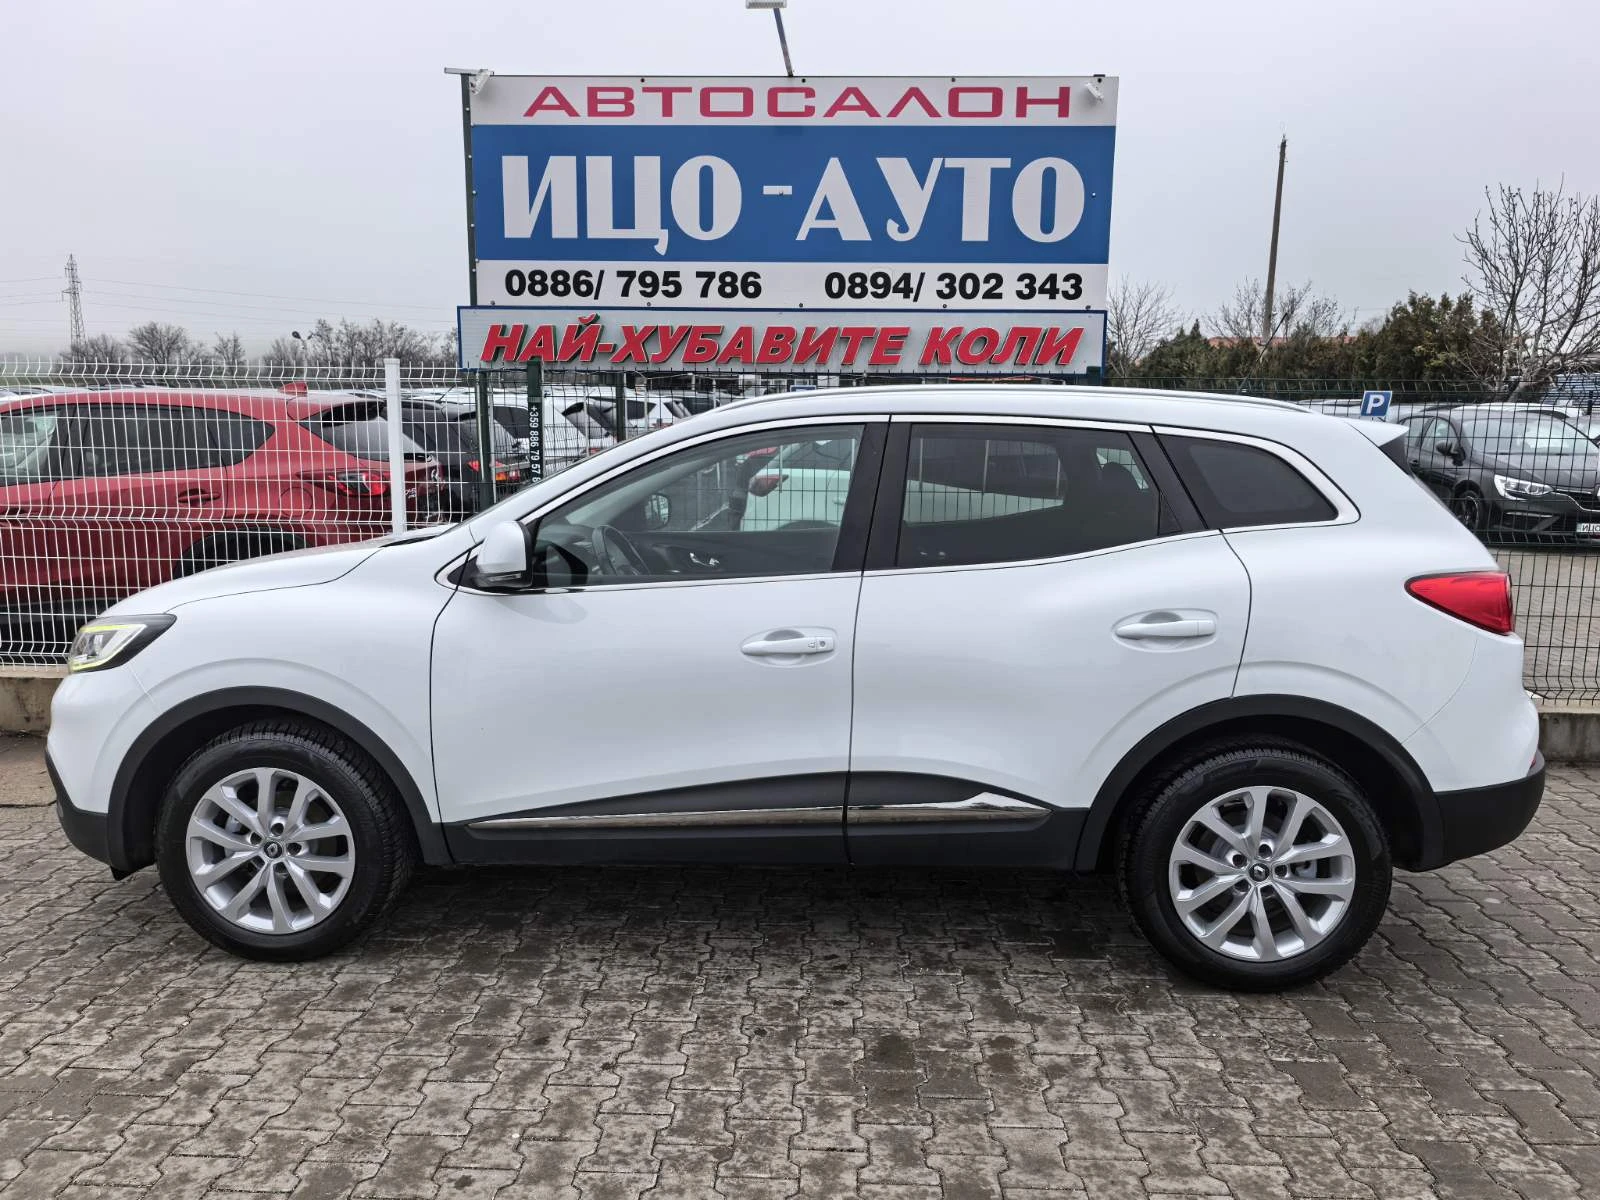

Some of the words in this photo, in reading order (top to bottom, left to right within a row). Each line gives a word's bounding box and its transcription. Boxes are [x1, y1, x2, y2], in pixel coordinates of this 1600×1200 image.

[523, 85, 1071, 118] АВТОСАЛОН
[504, 269, 604, 300] 0886/
[616, 270, 682, 299] 795
[695, 270, 762, 299] 786
[824, 271, 925, 302] 0894/
[936, 273, 1003, 301] 302
[1016, 273, 1083, 301] 343
[481, 313, 911, 367] НАЙ-ХУБАВИТЕ
[918, 324, 1084, 367] КОЛИ
[1366, 394, 1385, 414] P
[529, 405, 539, 428] +359
[530, 430, 539, 447] 886
[530, 449, 540, 461] 79
[531, 463, 541, 474] 57
